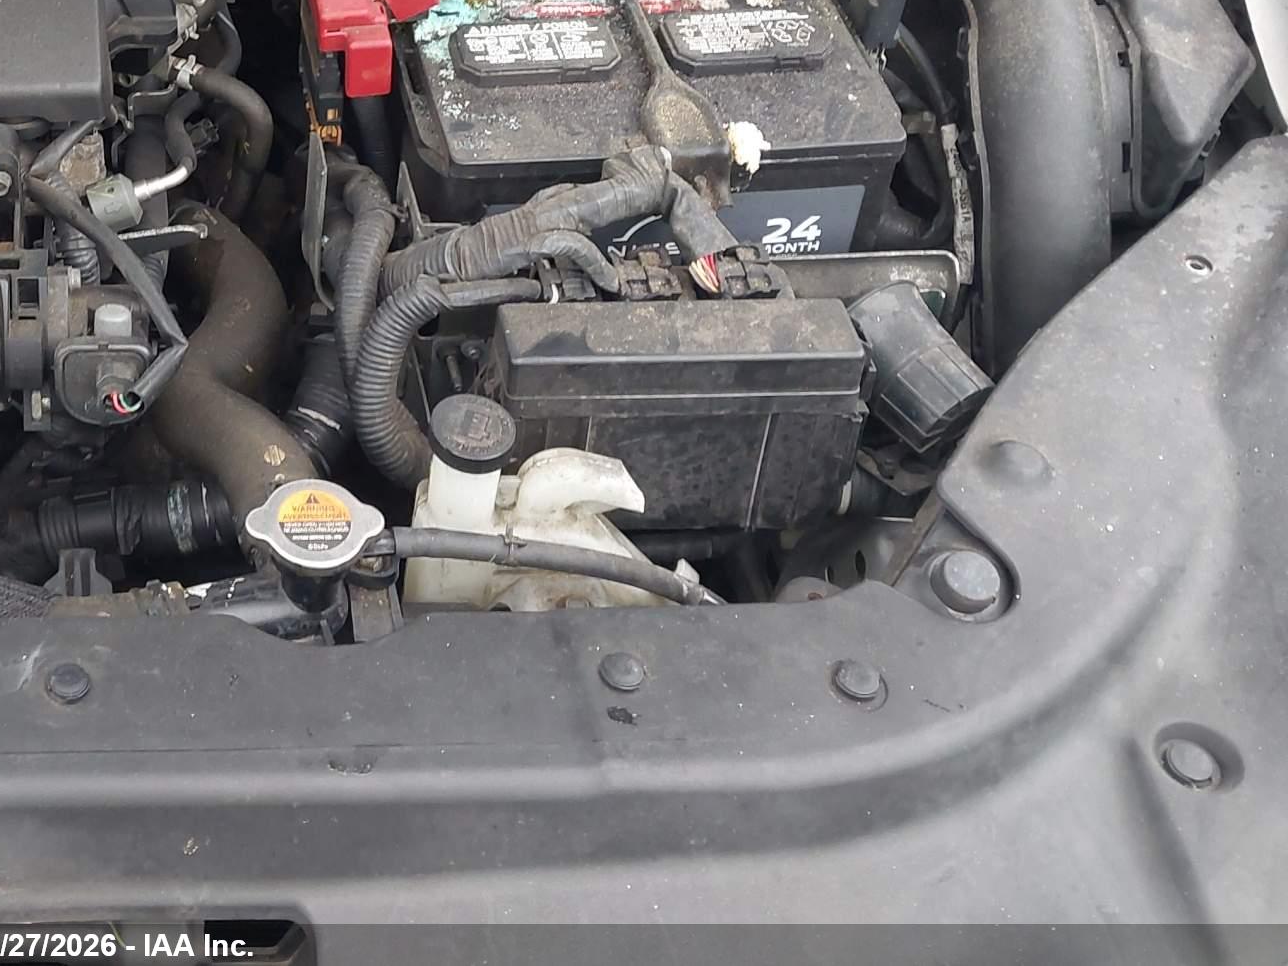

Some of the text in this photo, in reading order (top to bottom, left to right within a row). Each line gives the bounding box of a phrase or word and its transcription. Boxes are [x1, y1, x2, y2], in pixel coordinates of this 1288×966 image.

[480, 23, 530, 35] DANGER
[543, 20, 588, 32] POISON
[762, 215, 822, 244] 24
[291, 505, 336, 513] WARNING
